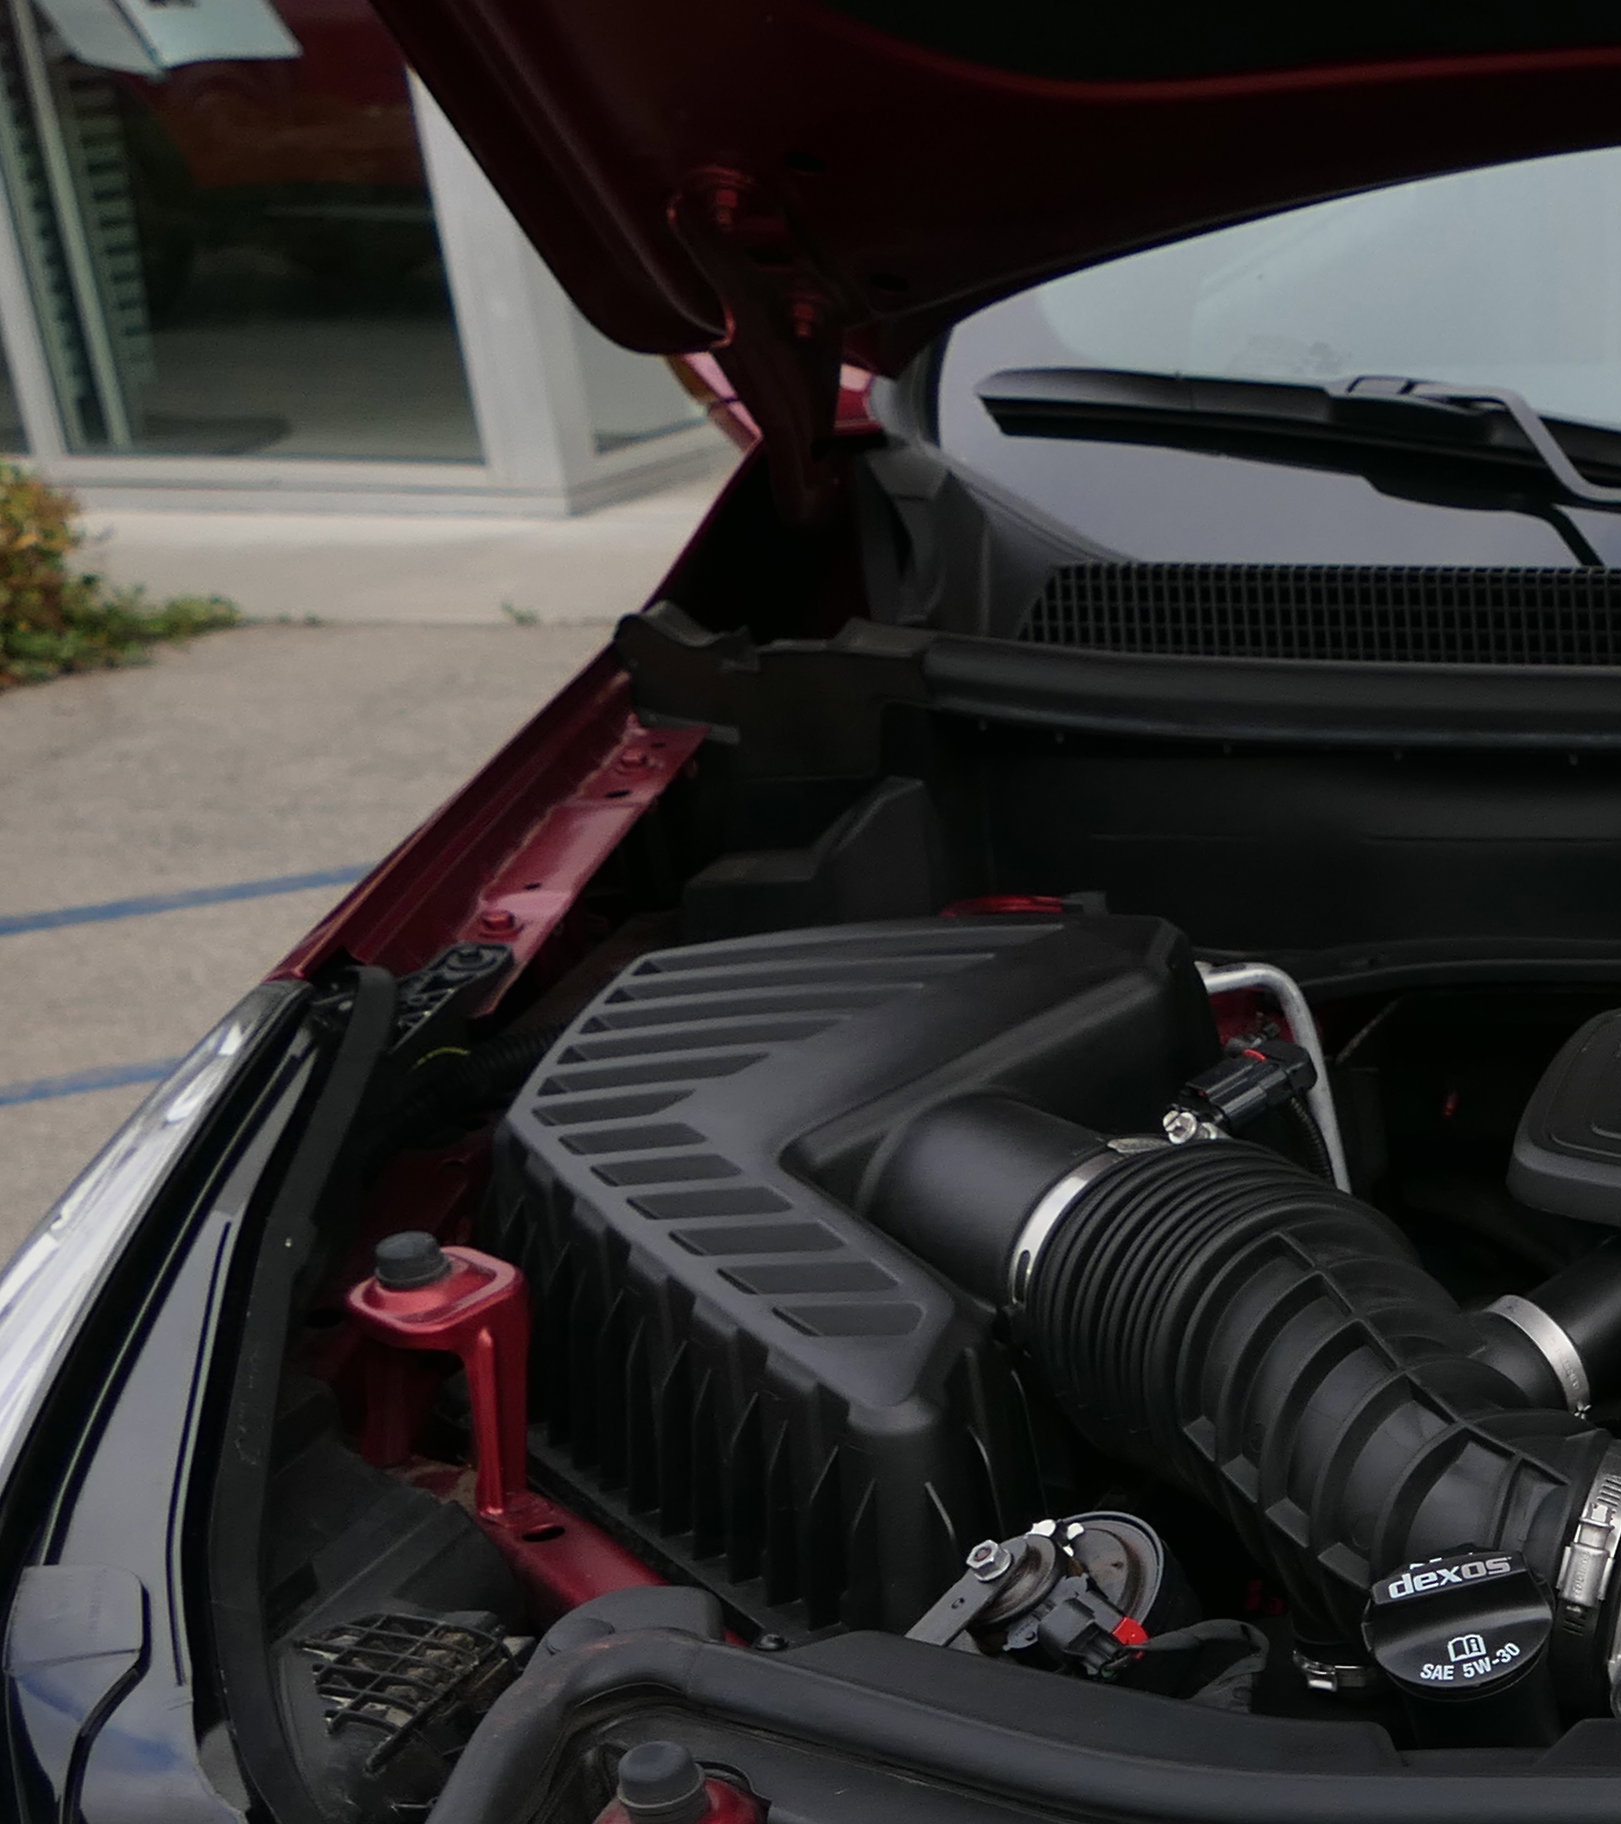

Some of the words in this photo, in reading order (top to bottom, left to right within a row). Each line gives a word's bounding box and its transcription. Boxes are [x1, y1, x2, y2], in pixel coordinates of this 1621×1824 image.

[1388, 1557, 1511, 1598] dexos
[1420, 1663, 1454, 1680] SAE
[1463, 1642, 1520, 1678] 5W-30
